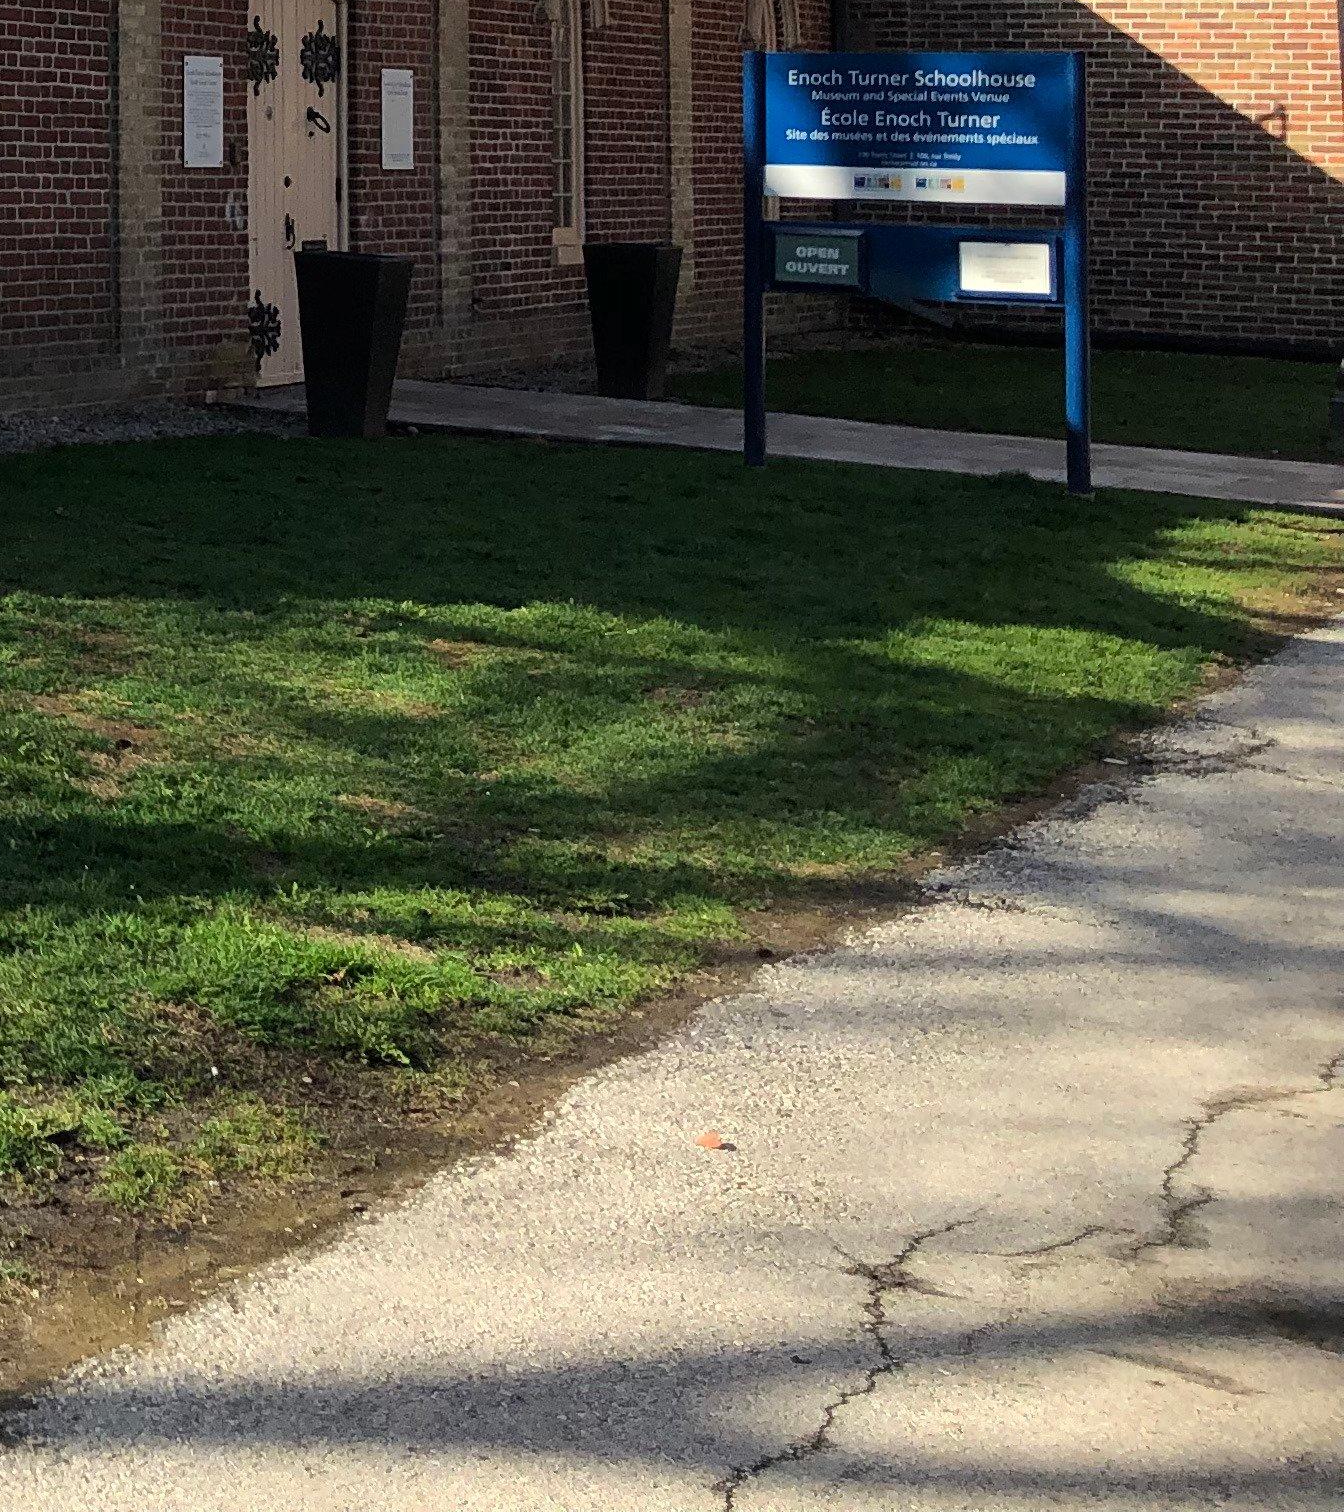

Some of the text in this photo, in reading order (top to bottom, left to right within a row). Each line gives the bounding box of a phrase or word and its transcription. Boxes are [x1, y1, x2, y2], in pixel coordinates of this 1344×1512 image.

[788, 69, 1036, 88] Enoch Turner Schoolhouse
[812, 90, 1010, 103] Museum and Special Events Venue
[822, 107, 1001, 128] École Enoch Turner
[786, 129, 1039, 147] Site des musées et des événements spéciaux
[796, 246, 839, 259] OPEN
[786, 261, 849, 275] OUVERT
